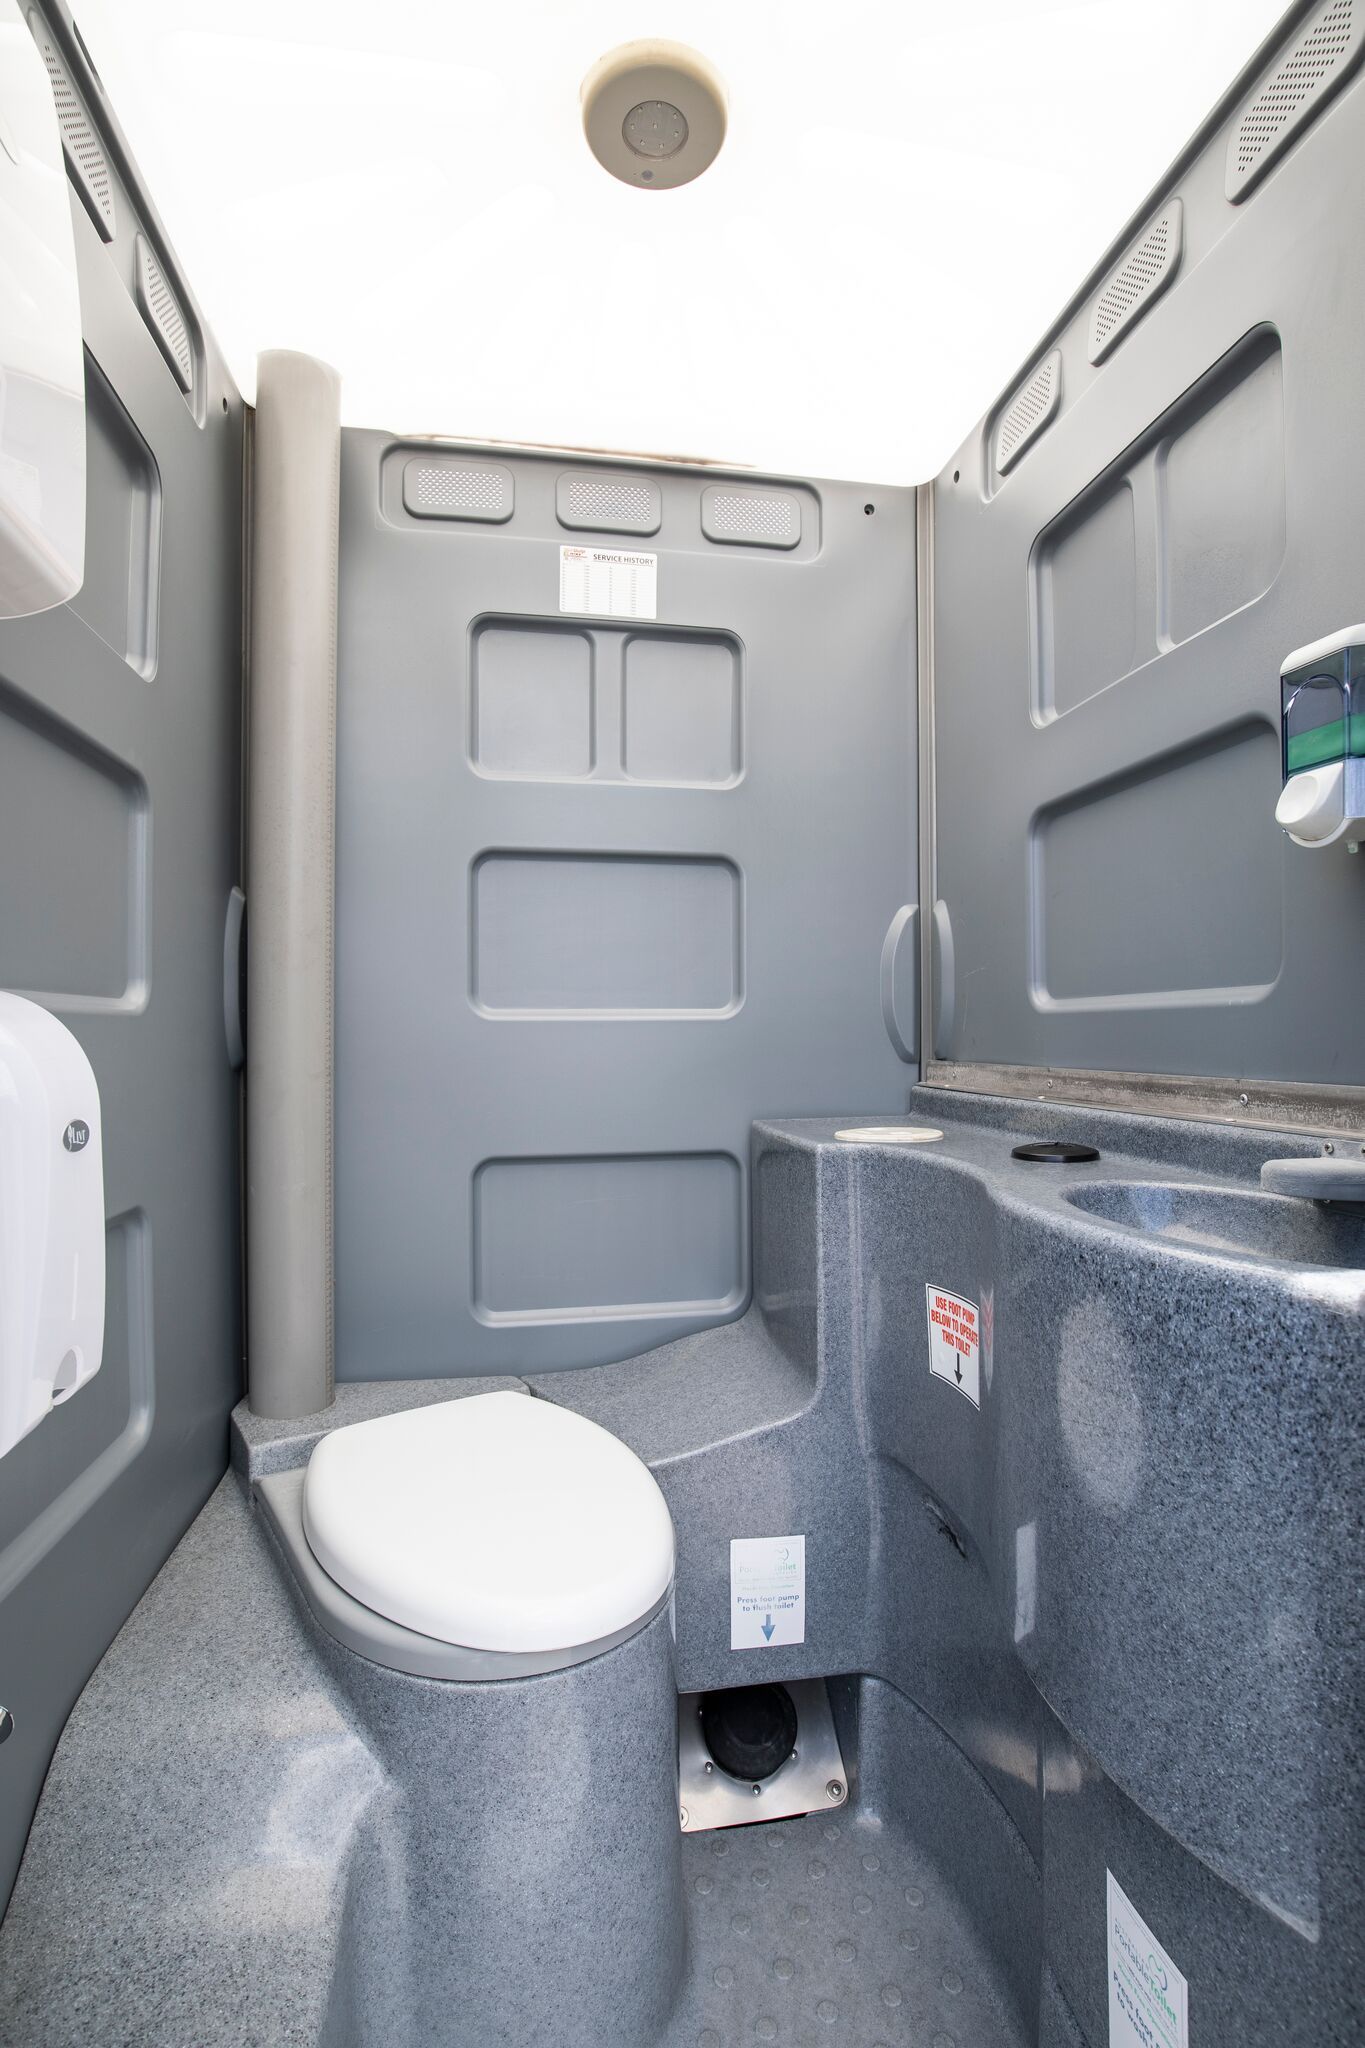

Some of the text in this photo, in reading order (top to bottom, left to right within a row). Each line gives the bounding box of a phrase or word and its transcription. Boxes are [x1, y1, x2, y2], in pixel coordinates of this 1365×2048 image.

[593, 553, 623, 563] SERVICE
[624, 556, 654, 565] HISTORY
[935, 1295, 975, 1327] USE FOOT PUMP
[930, 1309, 979, 1348] BELOW TO OPERATE
[942, 1328, 971, 1357] THIS TOILET
[737, 1596, 758, 1604] Press
[778, 1594, 800, 1602] pump
[753, 1603, 772, 1611] flush
[774, 1602, 794, 1610] toilet
[1113, 1970, 1133, 2010] Press
[1136, 2008, 1152, 2041] foot
[1117, 1992, 1149, 2048] to wash
